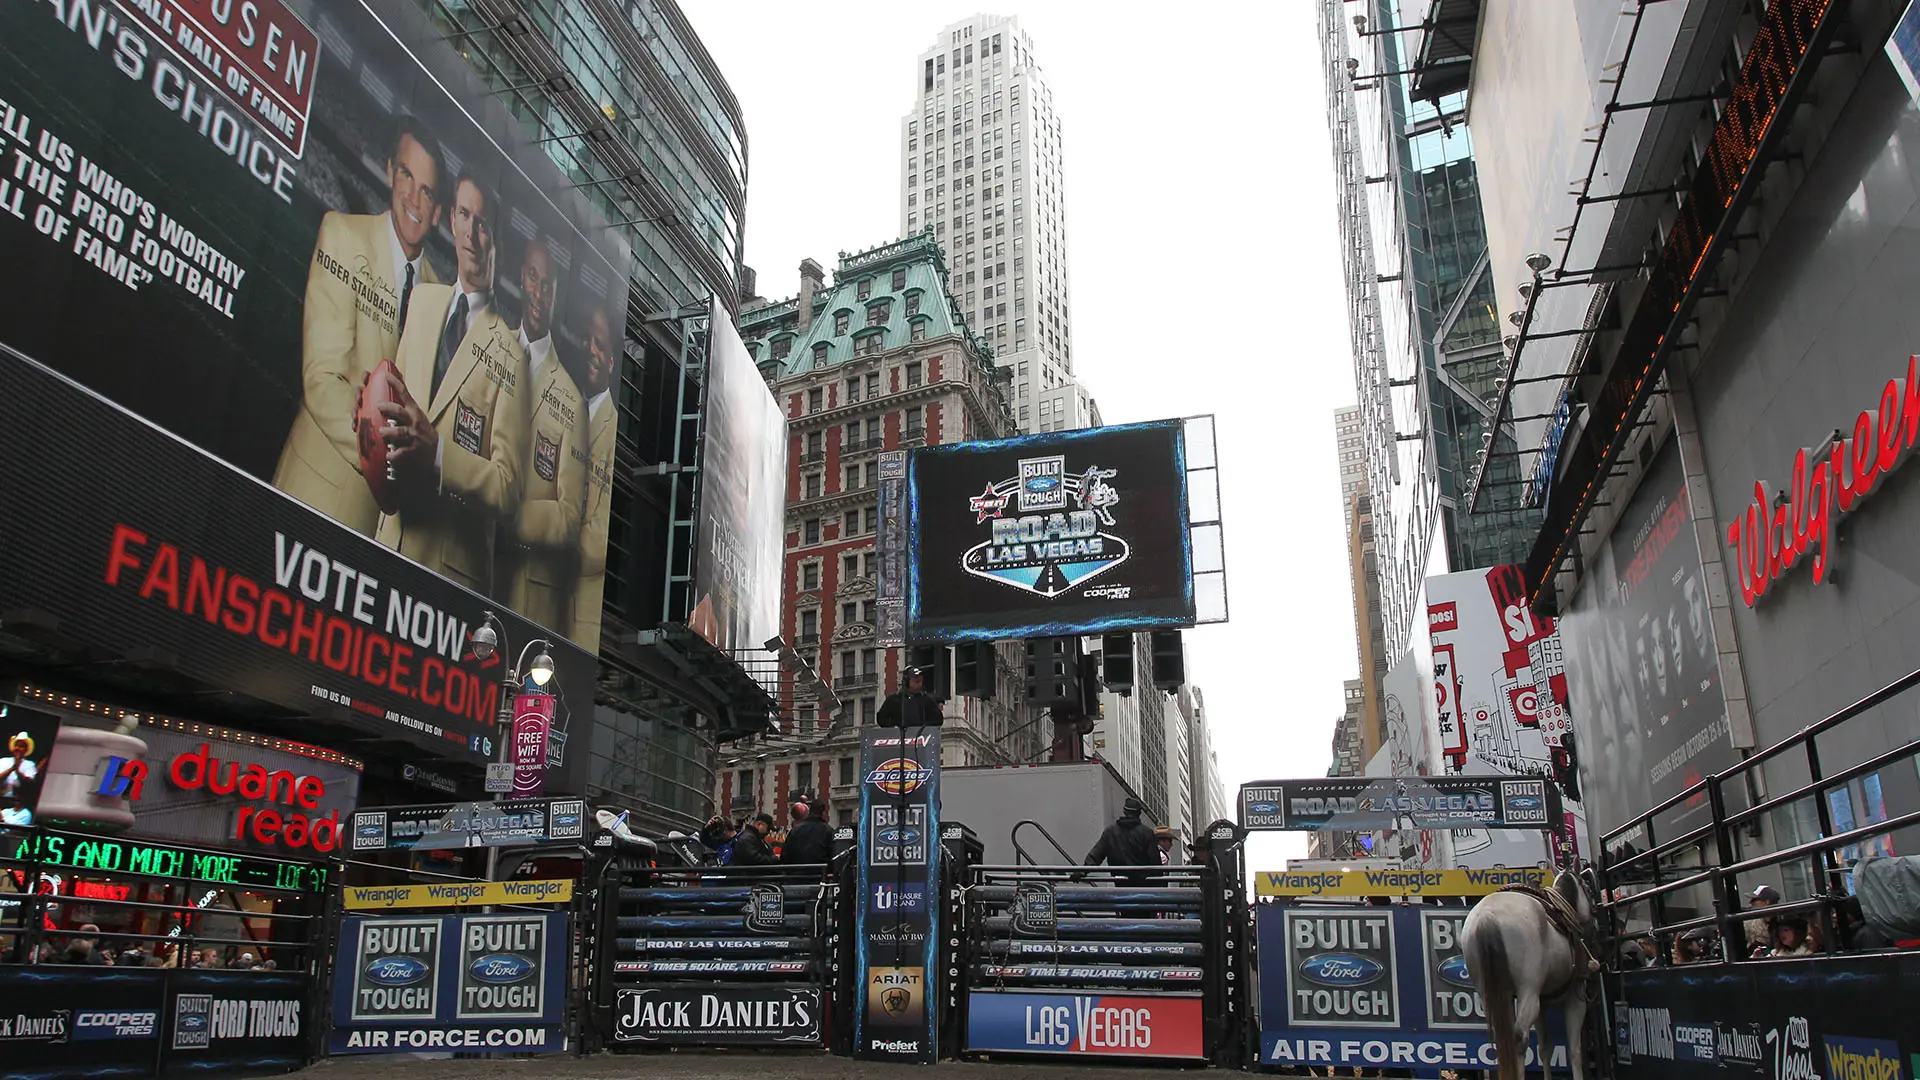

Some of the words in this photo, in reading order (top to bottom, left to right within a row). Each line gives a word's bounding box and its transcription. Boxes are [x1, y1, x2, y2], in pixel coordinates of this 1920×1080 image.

[176, 22, 223, 79] HALL
[226, 66, 250, 98] OF
[250, 85, 297, 141] FAME
[152, 58, 297, 205] CHOICE
[38, 129, 75, 173] US
[78, 156, 157, 230] WHO'S
[159, 213, 246, 290] WORTHY
[34, 203, 72, 243] OF
[13, 148, 68, 206] THE
[71, 189, 125, 243] PRO
[130, 229, 236, 320] FOOTBALL
[316, 248, 350, 285] ROGER
[351, 276, 397, 321] STAUBACH
[471, 343, 493, 369] STEVE
[493, 359, 517, 387] YOUNG
[541, 388, 561, 411] JERRY
[561, 402, 576, 423] RICE
[880, 453, 904, 463] BUILT
[880, 470, 904, 478] TOUGH
[1024, 462, 1060, 477] BUILT
[1024, 492, 1061, 504] TOUGH
[992, 510, 1098, 546] ROAD
[985, 544, 1028, 564] LAS
[1030, 538, 1104, 560] VEGAS
[274, 531, 379, 625] VOTE
[385, 588, 468, 663] NOW
[1083, 586, 1132, 598] COOPER
[105, 522, 500, 727] FANSCHOICE.COM
[311, 685, 328, 699] FIND
[329, 691, 339, 703] US
[340, 695, 351, 707] ON
[385, 710, 400, 723] AND
[400, 715, 425, 732] FOLLOW
[424, 723, 433, 735] US
[433, 726, 443, 738] ON
[517, 732, 543, 744] FREE
[1686, 728, 1710, 760] OCTOBER
[517, 745, 540, 757] WIFI
[170, 743, 325, 809] duane
[1246, 789, 1280, 802] BUILT
[1300, 784, 1386, 792] PROFESSIONAL
[1504, 782, 1541, 797] BUILT
[553, 803, 581, 815] BUILT
[1290, 797, 1357, 815] ROAD
[1370, 795, 1412, 812] LAS
[1418, 794, 1495, 811] VEGAS
[357, 815, 385, 826] BUILT
[392, 818, 442, 837] ROAD
[487, 813, 545, 830] VEGAS
[875, 808, 922, 826] BULT
[1247, 815, 1282, 826] TOUGH
[1506, 809, 1544, 821] TOUGH
[552, 826, 580, 836] TOUGH
[356, 836, 384, 847] TOUGH
[72, 841, 121, 871] AND
[129, 846, 185, 877] MUCH
[192, 852, 243, 884] MORE
[503, 881, 563, 901] Wrangler
[1267, 872, 1343, 894] Wrangler
[1364, 871, 1443, 893] Wrangler
[354, 887, 411, 906] Wrangler
[427, 885, 486, 904] Wrangler
[761, 894, 782, 902] BUILT
[875, 885, 892, 909] ti
[1029, 894, 1051, 903] BUILT
[1029, 911, 1051, 919] TOUGH
[365, 926, 436, 954] BUILT
[467, 924, 541, 952] BUILT
[869, 933, 909, 941] MANDAAY
[911, 933, 925, 941] BAY
[1294, 918, 1386, 949] BUILT
[949, 889, 960, 1008] Priefert
[1071, 945, 1098, 953] LAS
[1103, 946, 1152, 954] VEGAS
[1223, 889, 1235, 1013] Priefert
[379, 962, 413, 979] Ford
[484, 960, 519, 977] Ford
[653, 963, 687, 971] TIMES
[689, 963, 738, 972] SQUARE,
[742, 963, 767, 971] NYC
[1071, 968, 1128, 979] SQUARE,
[1132, 970, 1159, 979] NYC
[1319, 960, 1364, 979] Ford
[872, 975, 920, 984] ARIAT
[178, 998, 210, 1014] BUILT
[360, 988, 430, 1010] TOUGH
[465, 986, 537, 1009] TOUGH
[1296, 989, 1389, 1016] TOUGH
[76, 1012, 157, 1028] COOPER
[210, 999, 248, 1039] FORD
[249, 999, 300, 1039] TRUCKS
[621, 995, 692, 1028] JACK
[700, 994, 811, 1028] DANIEL'S
[15, 1014, 66, 1037] DANIEL'S
[114, 1025, 153, 1037] TIRES
[1026, 1005, 1070, 1045] LAS
[1075, 996, 1151, 1052] VEGAS
[177, 1031, 207, 1045] TOUGH
[347, 1031, 389, 1048] AIR
[394, 1028, 546, 1047] FORCE.COM
[871, 1039, 918, 1050] Priefert
[1675, 1026, 1714, 1046] COOPER
[1717, 1026, 1735, 1057] JACK
[1271, 1038, 1331, 1061] AIR
[1693, 1044, 1714, 1059] TIRES
[1766, 1024, 1822, 1080] Vegas
[1825, 1043, 1901, 1080] Wrangler
